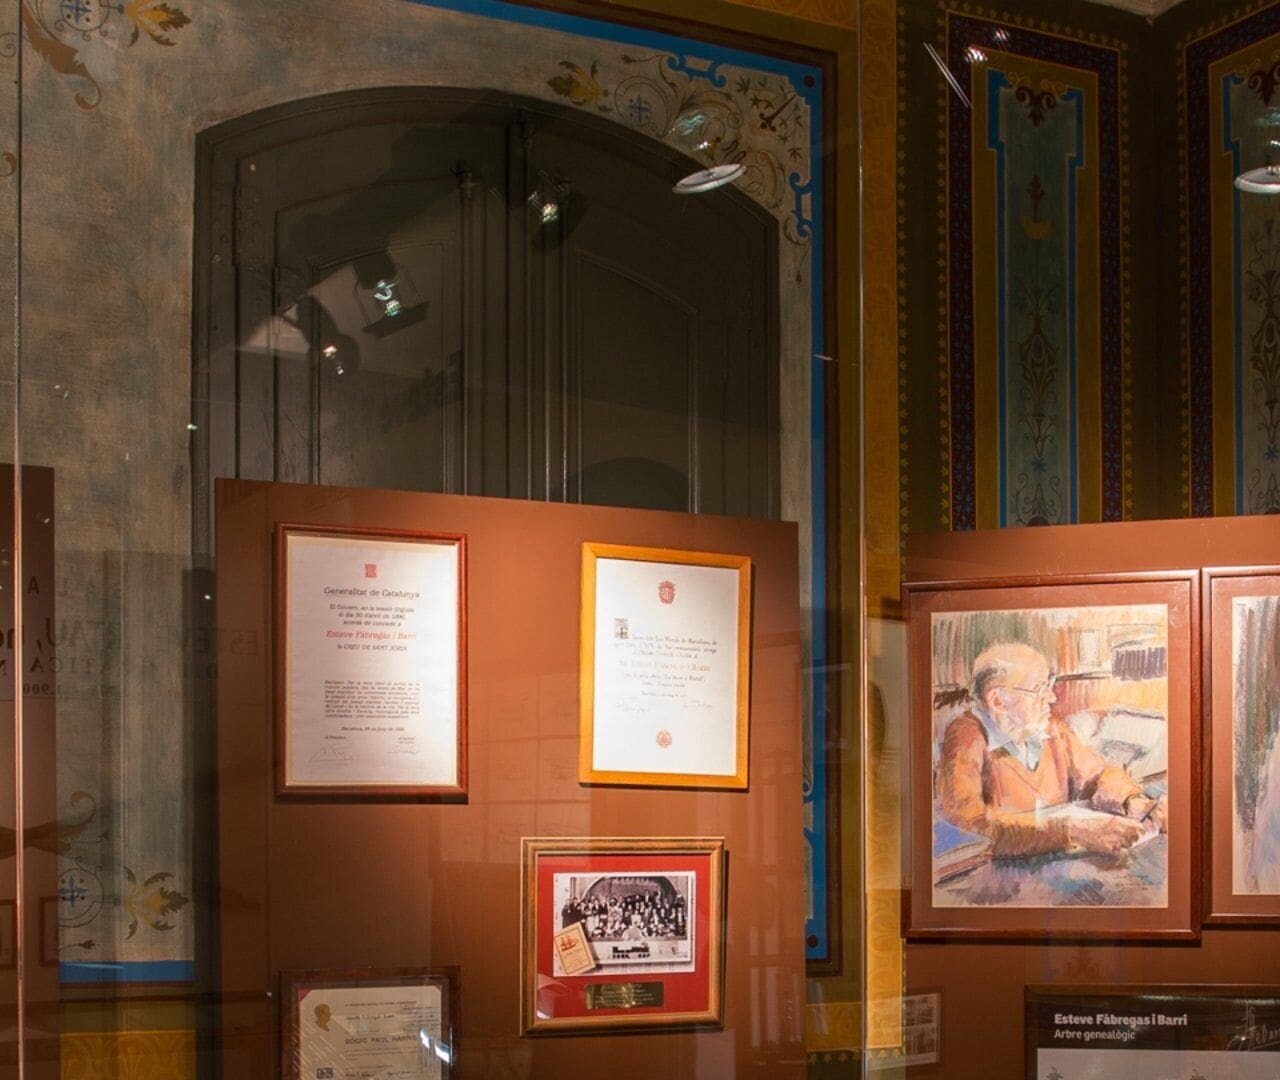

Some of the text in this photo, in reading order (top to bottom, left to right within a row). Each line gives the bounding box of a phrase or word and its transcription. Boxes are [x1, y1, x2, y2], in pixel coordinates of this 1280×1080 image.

[323, 587, 421, 599] Generalitat de Catalunya
[1054, 1011, 1188, 1028] Esteve Fàbregas i Barri
[1054, 1028, 1136, 1043] Arbre genealògic
